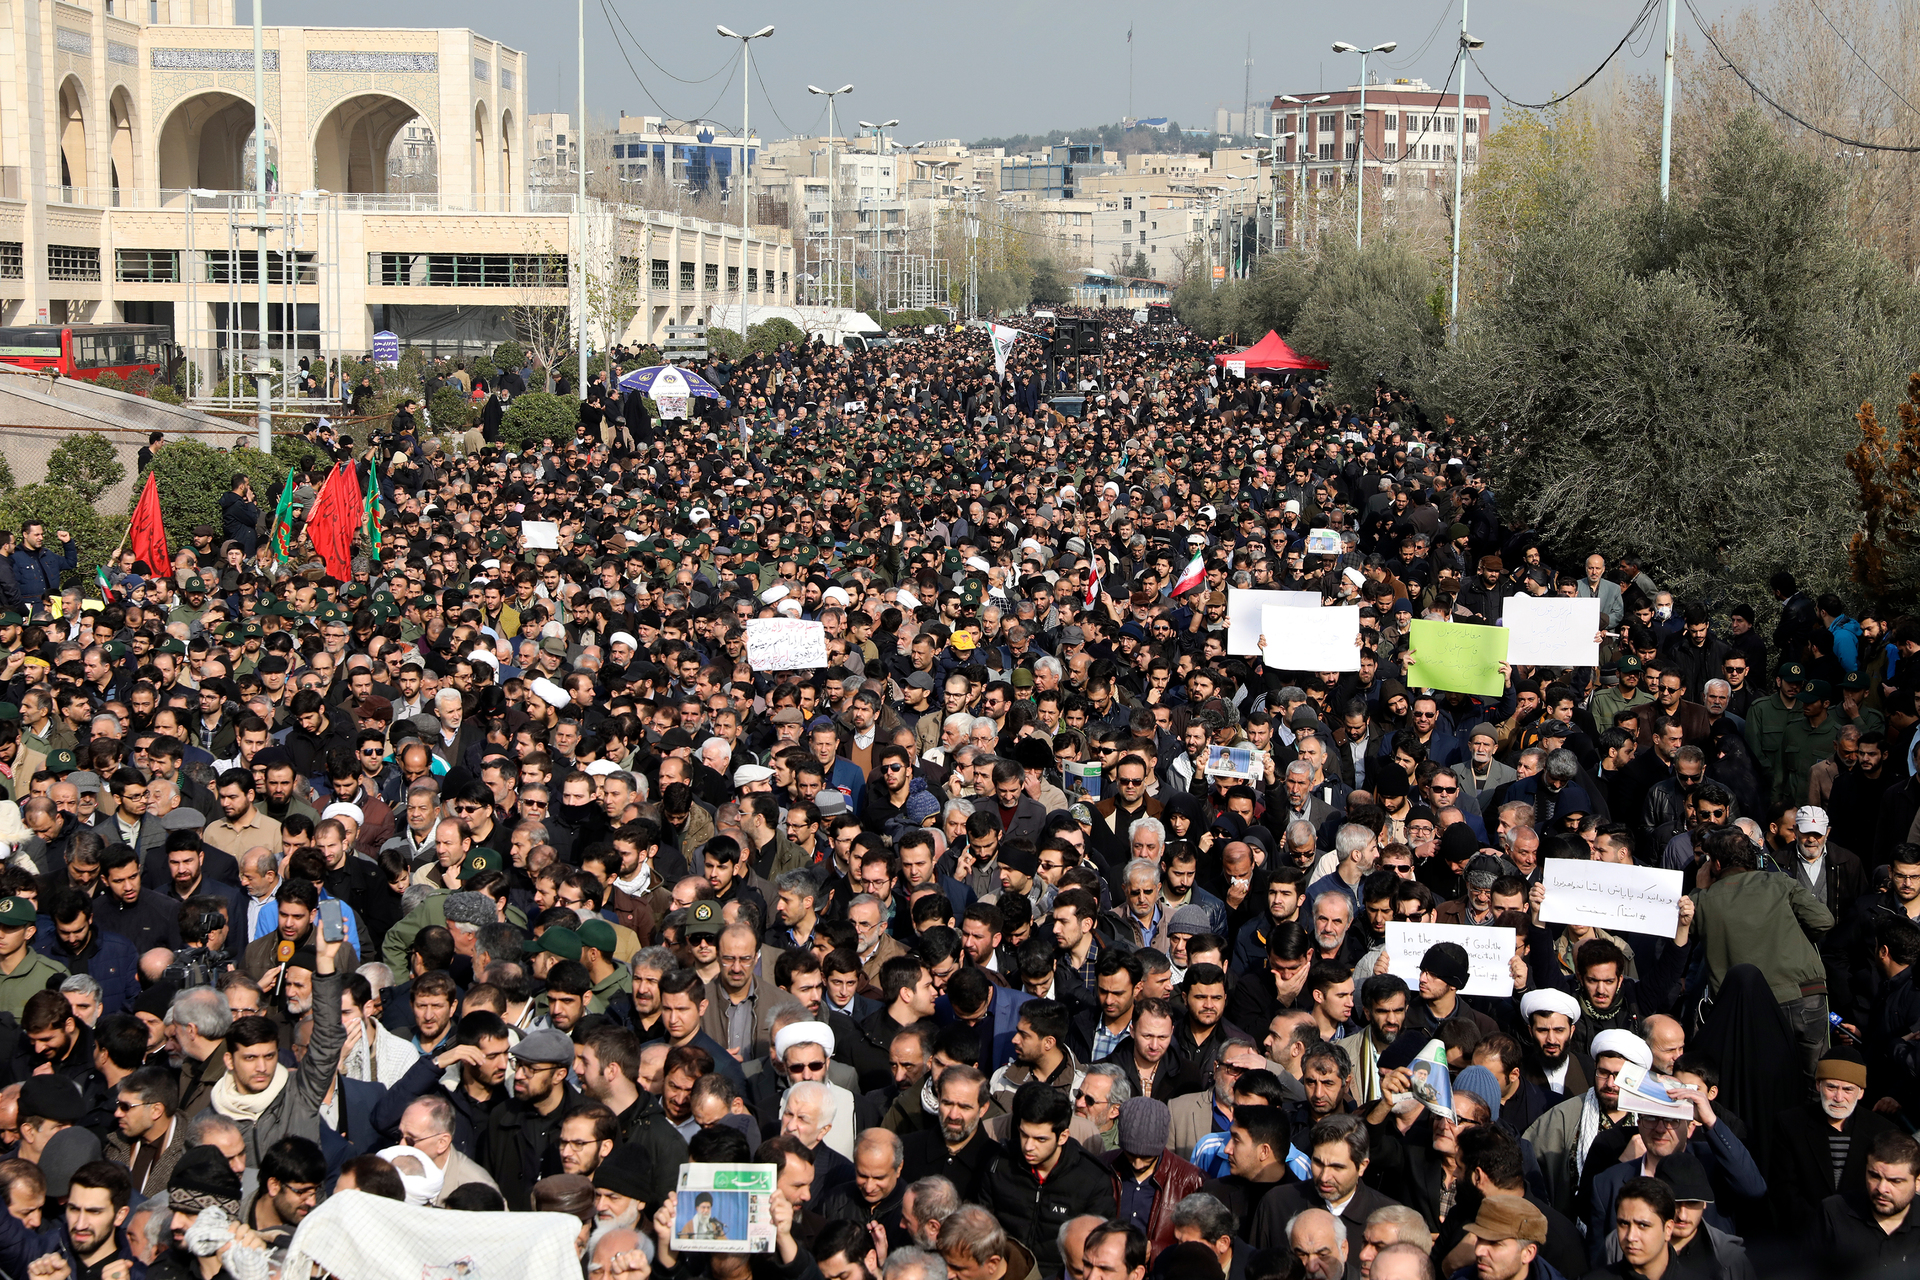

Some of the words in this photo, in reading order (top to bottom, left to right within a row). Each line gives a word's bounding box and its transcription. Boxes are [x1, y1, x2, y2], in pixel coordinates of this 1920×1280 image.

[1457, 643, 1478, 657] قاسم
[1403, 932, 1413, 943] In
[1418, 933, 1432, 944] the
